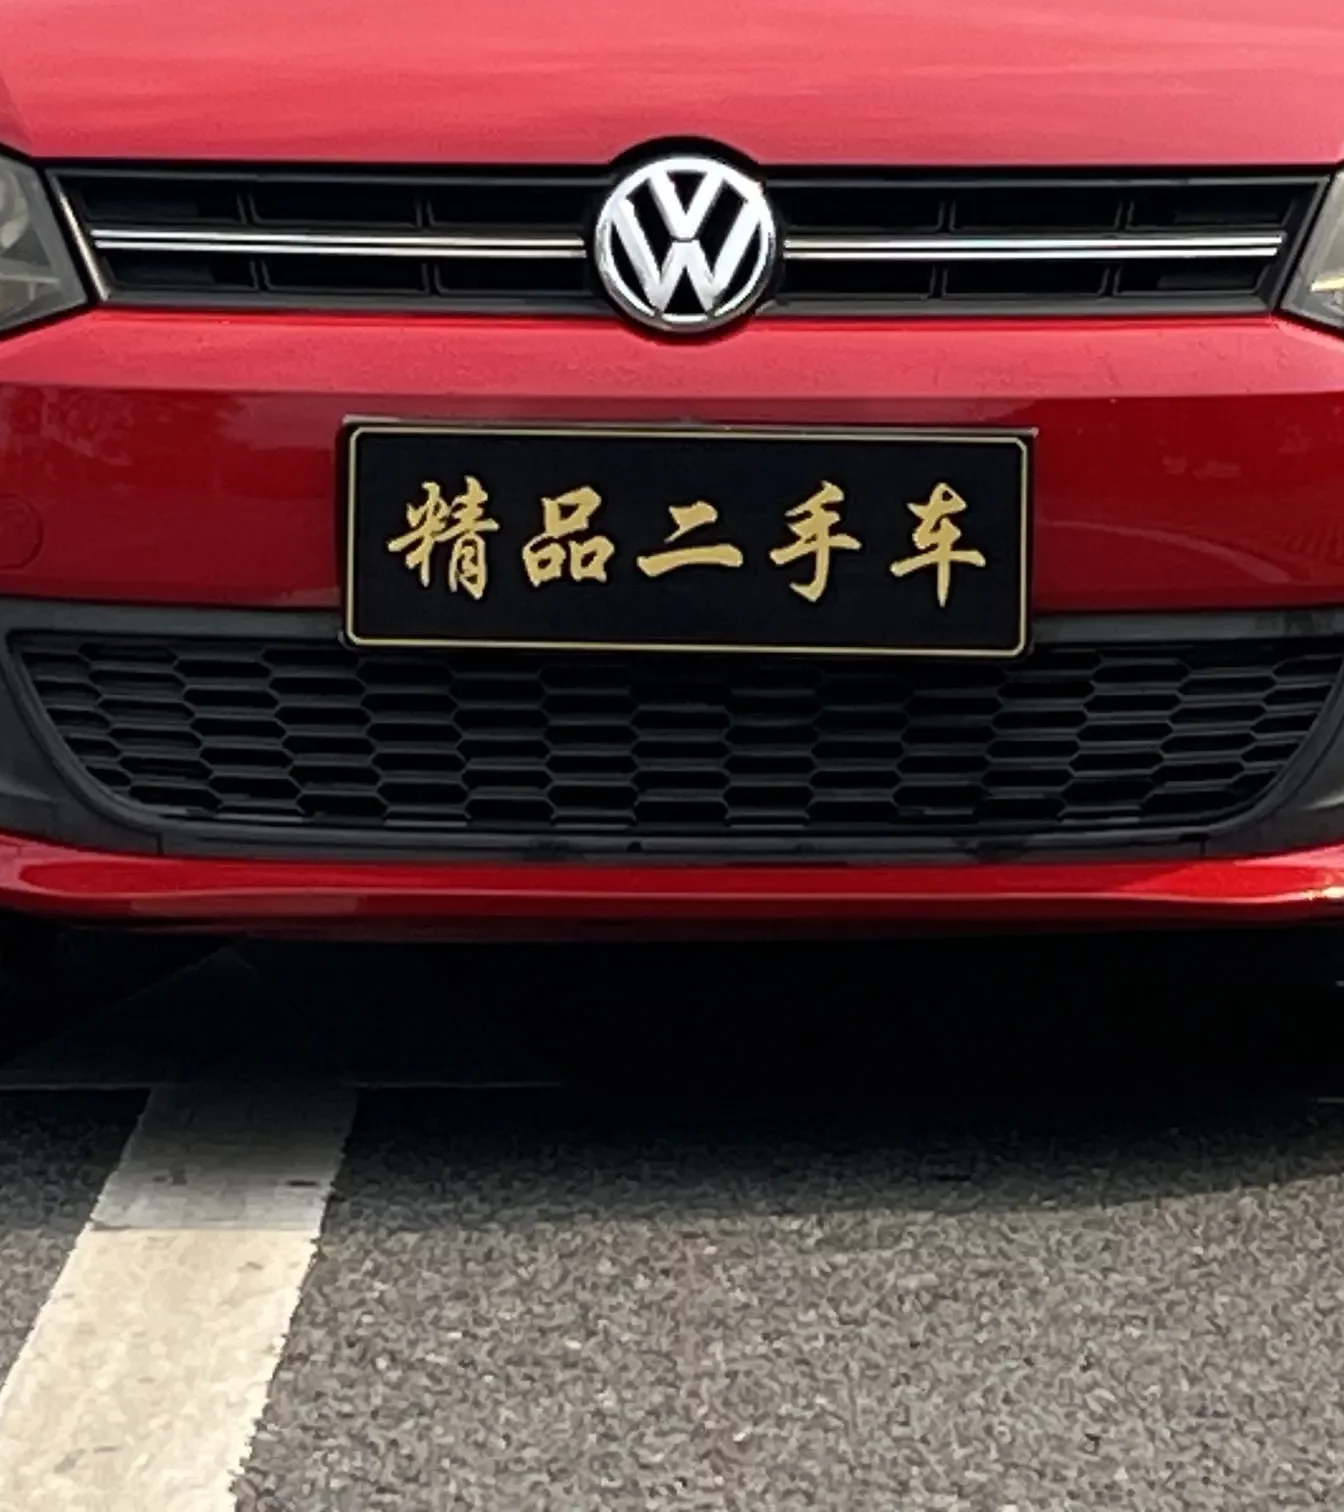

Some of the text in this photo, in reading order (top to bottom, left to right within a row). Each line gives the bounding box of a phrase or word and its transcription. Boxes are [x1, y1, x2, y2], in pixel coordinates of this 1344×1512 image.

[602, 162, 769, 324] VW
[387, 475, 987, 607] 精品二手车
